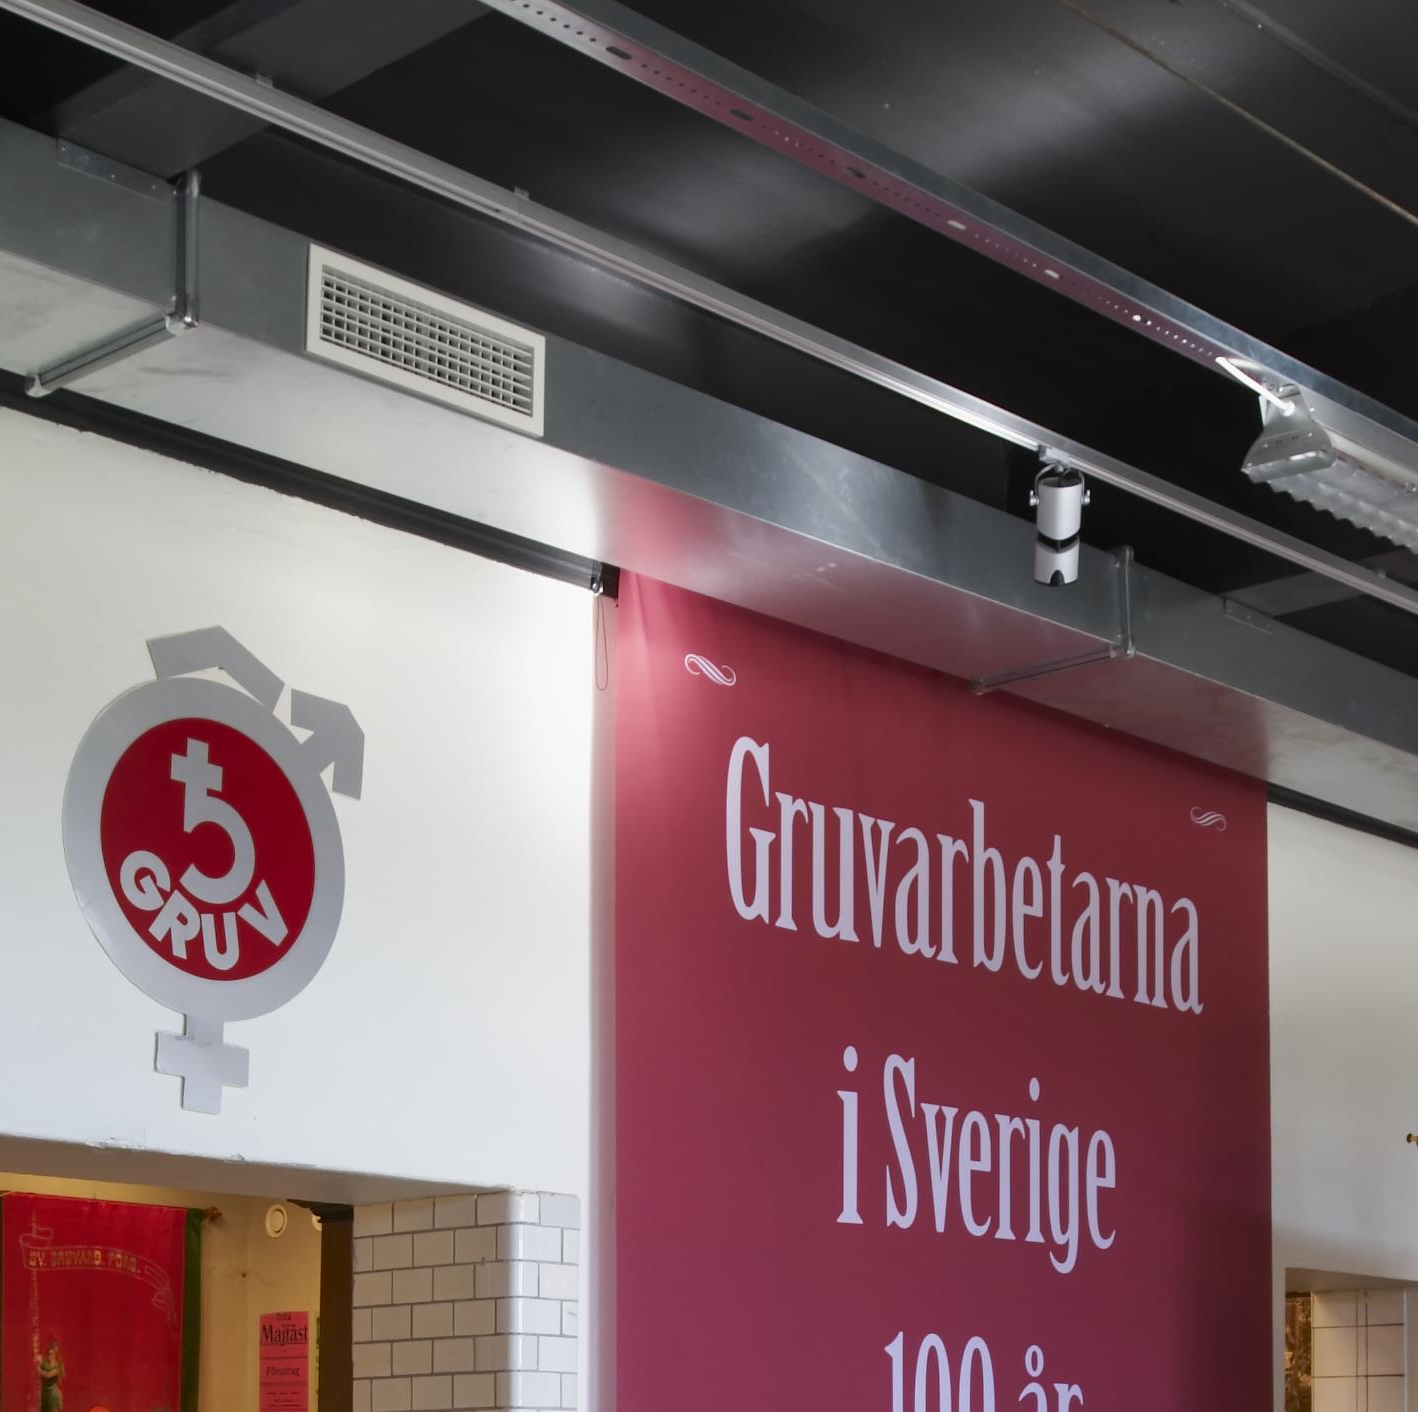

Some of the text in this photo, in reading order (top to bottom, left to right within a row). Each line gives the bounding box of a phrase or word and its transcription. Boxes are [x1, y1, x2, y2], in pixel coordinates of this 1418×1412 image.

[120, 850, 288, 970] GRUV
[726, 737, 1202, 1013] Gruvarbetarna
[837, 1046, 1115, 1273] i Sverige
